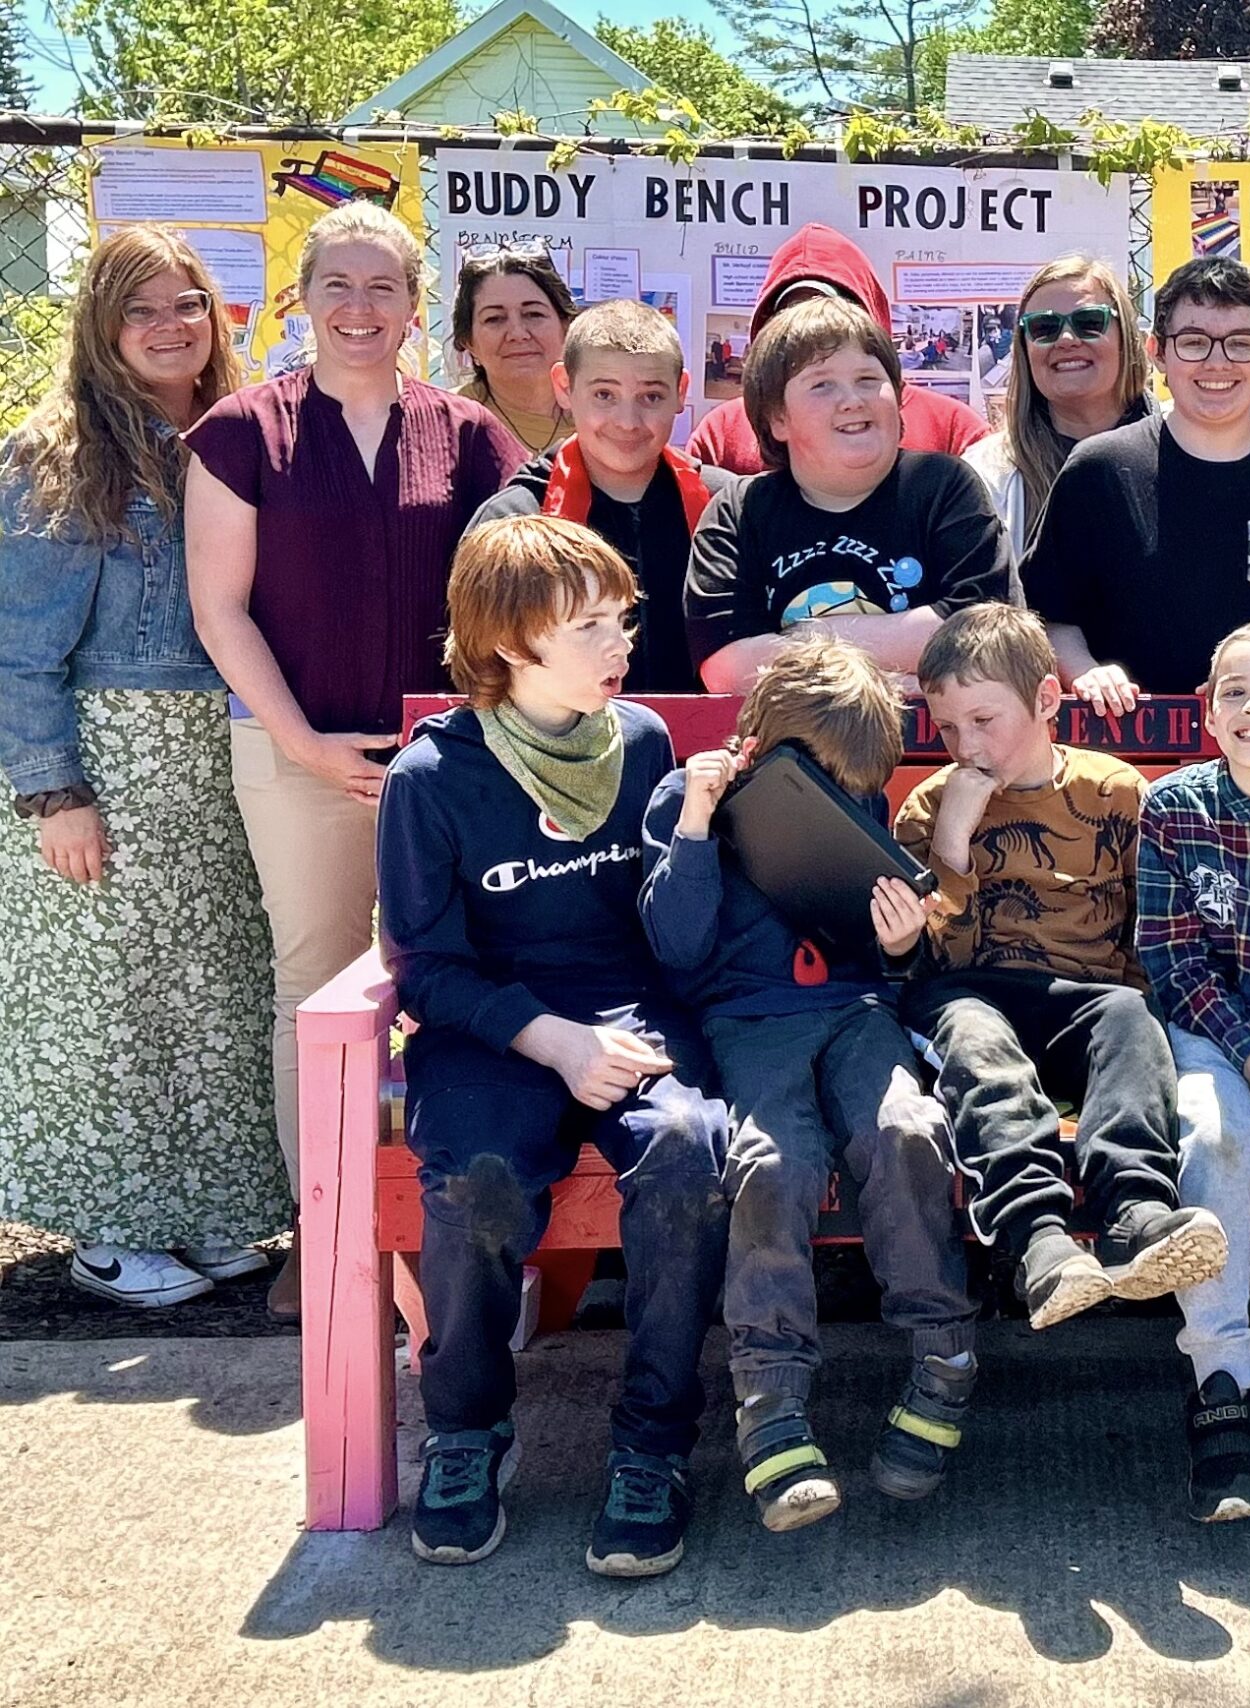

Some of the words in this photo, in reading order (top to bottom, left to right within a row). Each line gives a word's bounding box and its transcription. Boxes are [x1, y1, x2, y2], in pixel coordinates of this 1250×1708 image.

[447, 171, 596, 218] BUDDY
[645, 176, 790, 226] BENCH
[858, 185, 1053, 233] PROJECT
[714, 241, 759, 255] BUILD
[1050, 707, 1192, 745] ENCH
